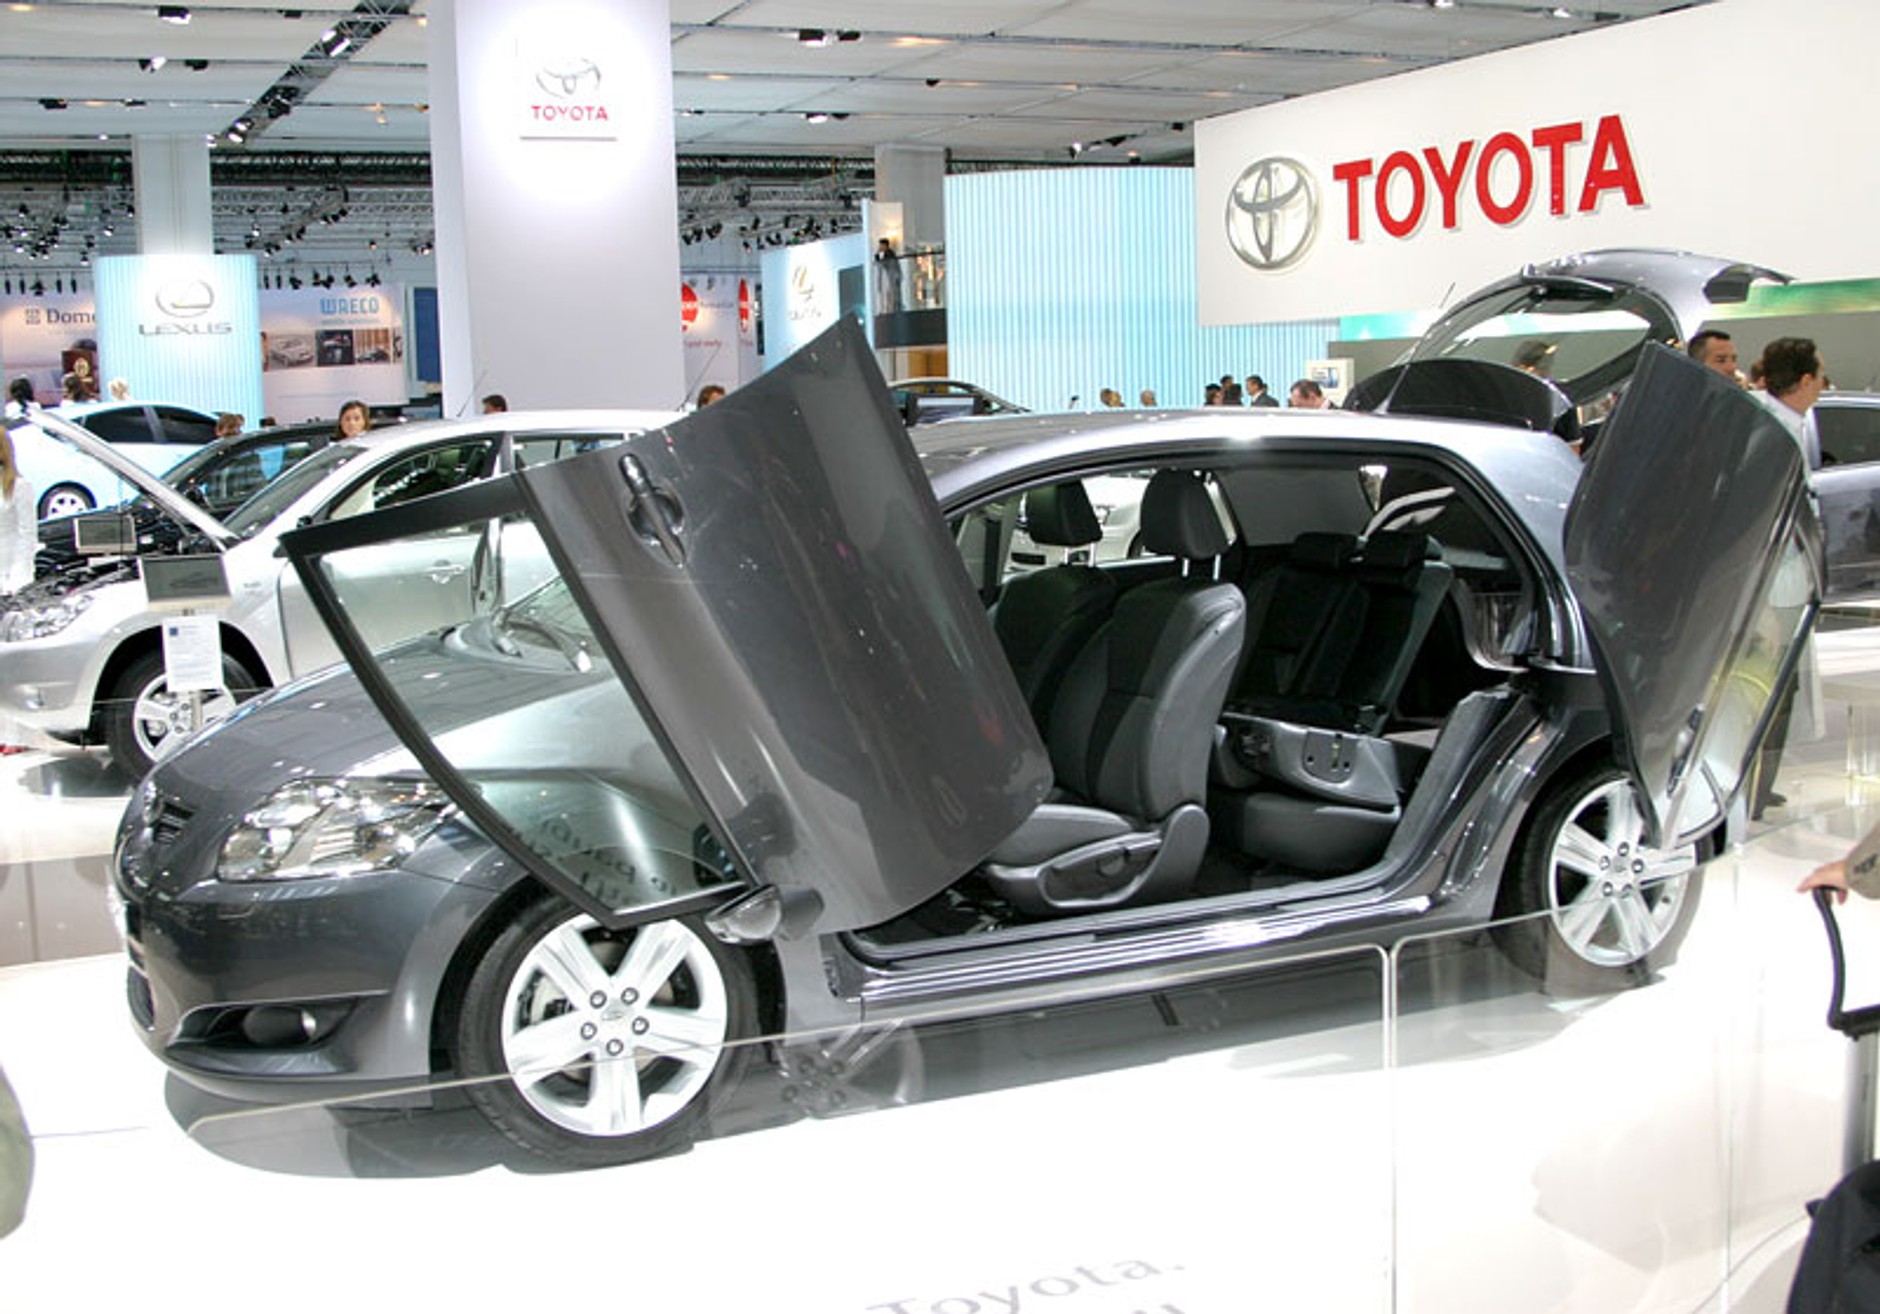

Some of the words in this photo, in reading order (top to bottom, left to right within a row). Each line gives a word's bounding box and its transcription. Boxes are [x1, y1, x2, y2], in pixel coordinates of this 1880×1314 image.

[531, 105, 609, 121] TOYOTA
[1333, 114, 1645, 241] TOYOTA
[139, 322, 232, 336] LEXUS
